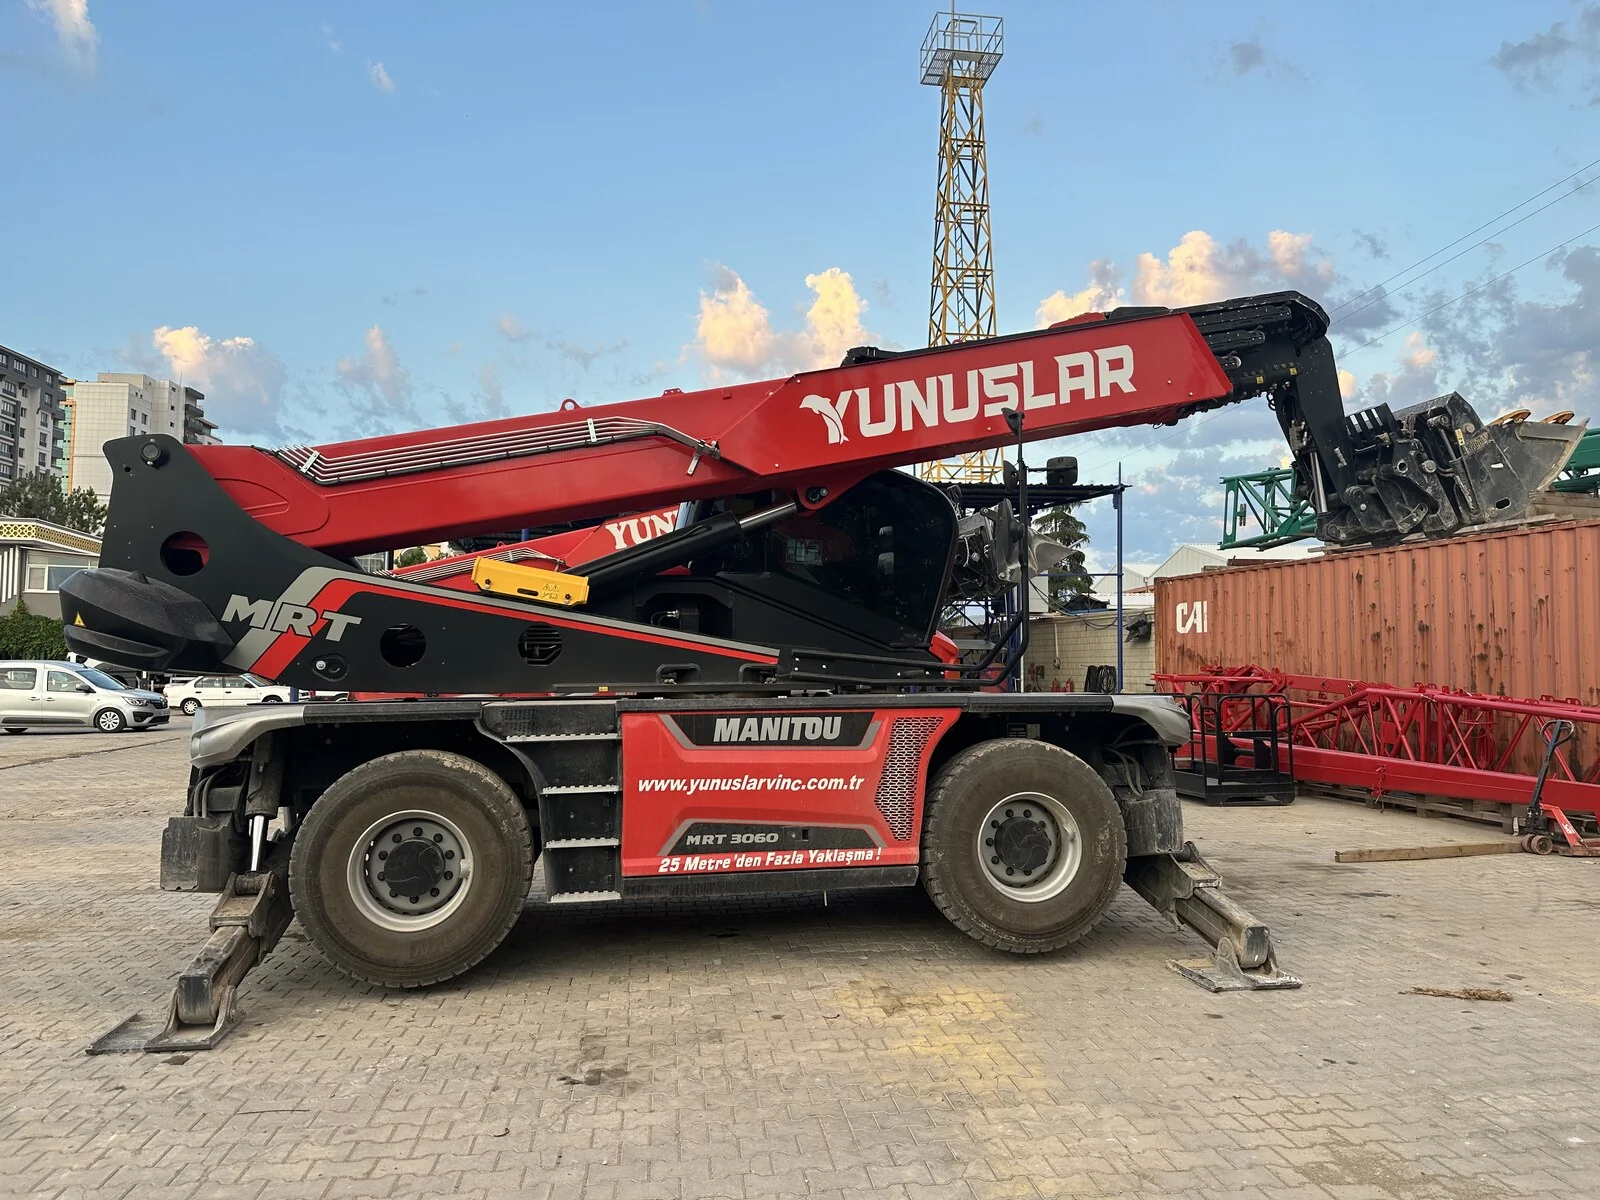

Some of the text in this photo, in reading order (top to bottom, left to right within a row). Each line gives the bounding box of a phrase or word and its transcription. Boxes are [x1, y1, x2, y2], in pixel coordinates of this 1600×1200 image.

[800, 345, 1137, 445] YUNUSLAR
[220, 594, 363, 642] MRT
[1176, 600, 1208, 634] CAI
[713, 716, 842, 743] MANITOU
[638, 774, 865, 796] www.yunuslarvinc.com.tr
[686, 833, 779, 845] MRT 3060
[658, 857, 681, 873] 25
[765, 850, 804, 866] Fazla
